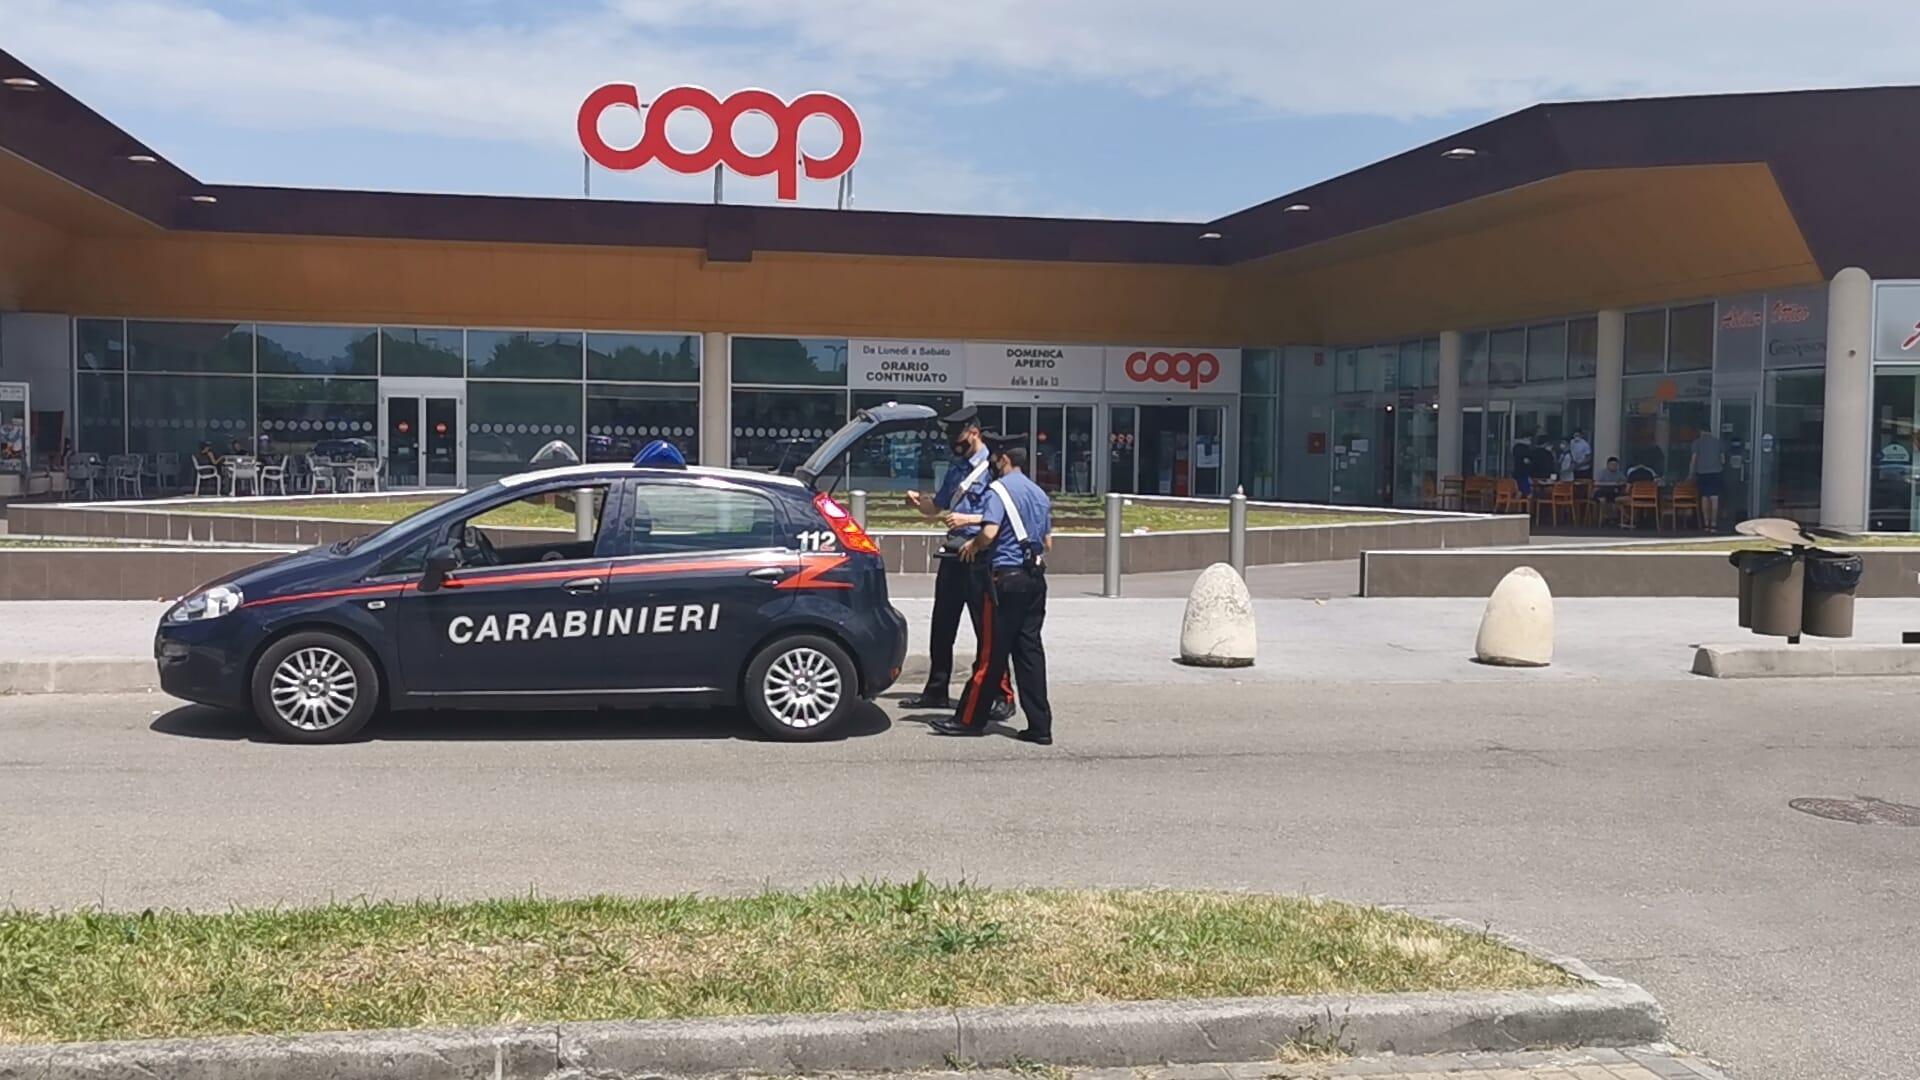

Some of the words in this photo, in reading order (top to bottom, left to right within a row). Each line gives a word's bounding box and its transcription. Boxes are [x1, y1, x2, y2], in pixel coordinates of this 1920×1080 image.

[577, 83, 862, 201] coop
[862, 345, 875, 354] Da
[919, 346, 951, 356] Sabato
[1006, 348, 1064, 359] DOMENICA
[881, 361, 929, 371] ORARIO
[1015, 359, 1055, 368] APERTO
[1125, 351, 1220, 390] coop
[866, 371, 948, 383] CONTINUATO
[796, 530, 836, 551] 112
[449, 603, 721, 644] CARABINIERI
